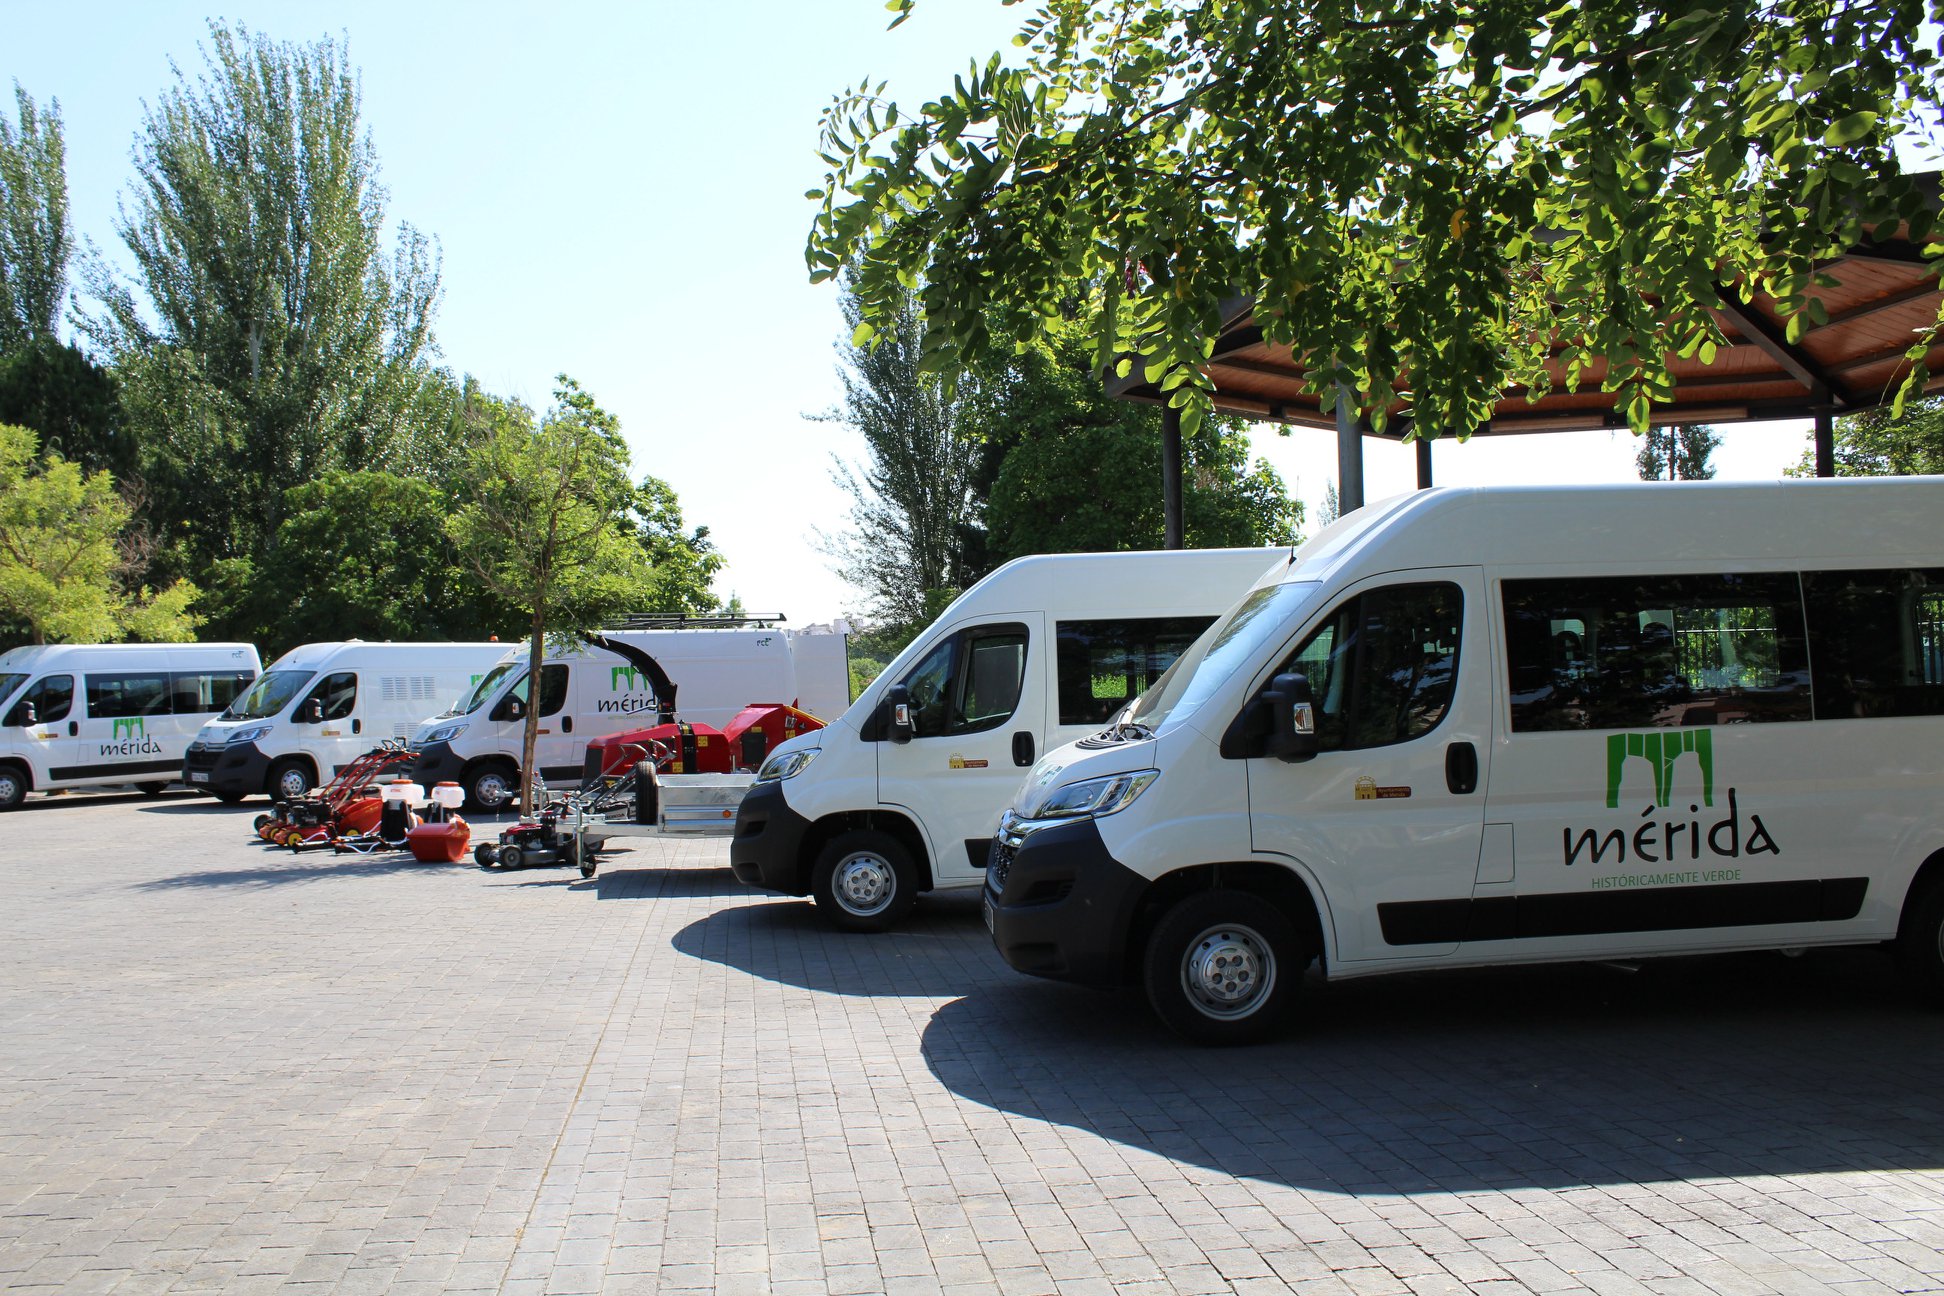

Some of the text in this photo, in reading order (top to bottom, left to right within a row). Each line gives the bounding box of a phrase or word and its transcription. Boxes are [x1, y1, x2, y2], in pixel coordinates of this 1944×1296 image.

[598, 689, 657, 713] mérid
[100, 733, 162, 756] mérida
[1563, 787, 1780, 866] mérida
[1591, 870, 1741, 889] HISTÓRICAMENTE VERDE
